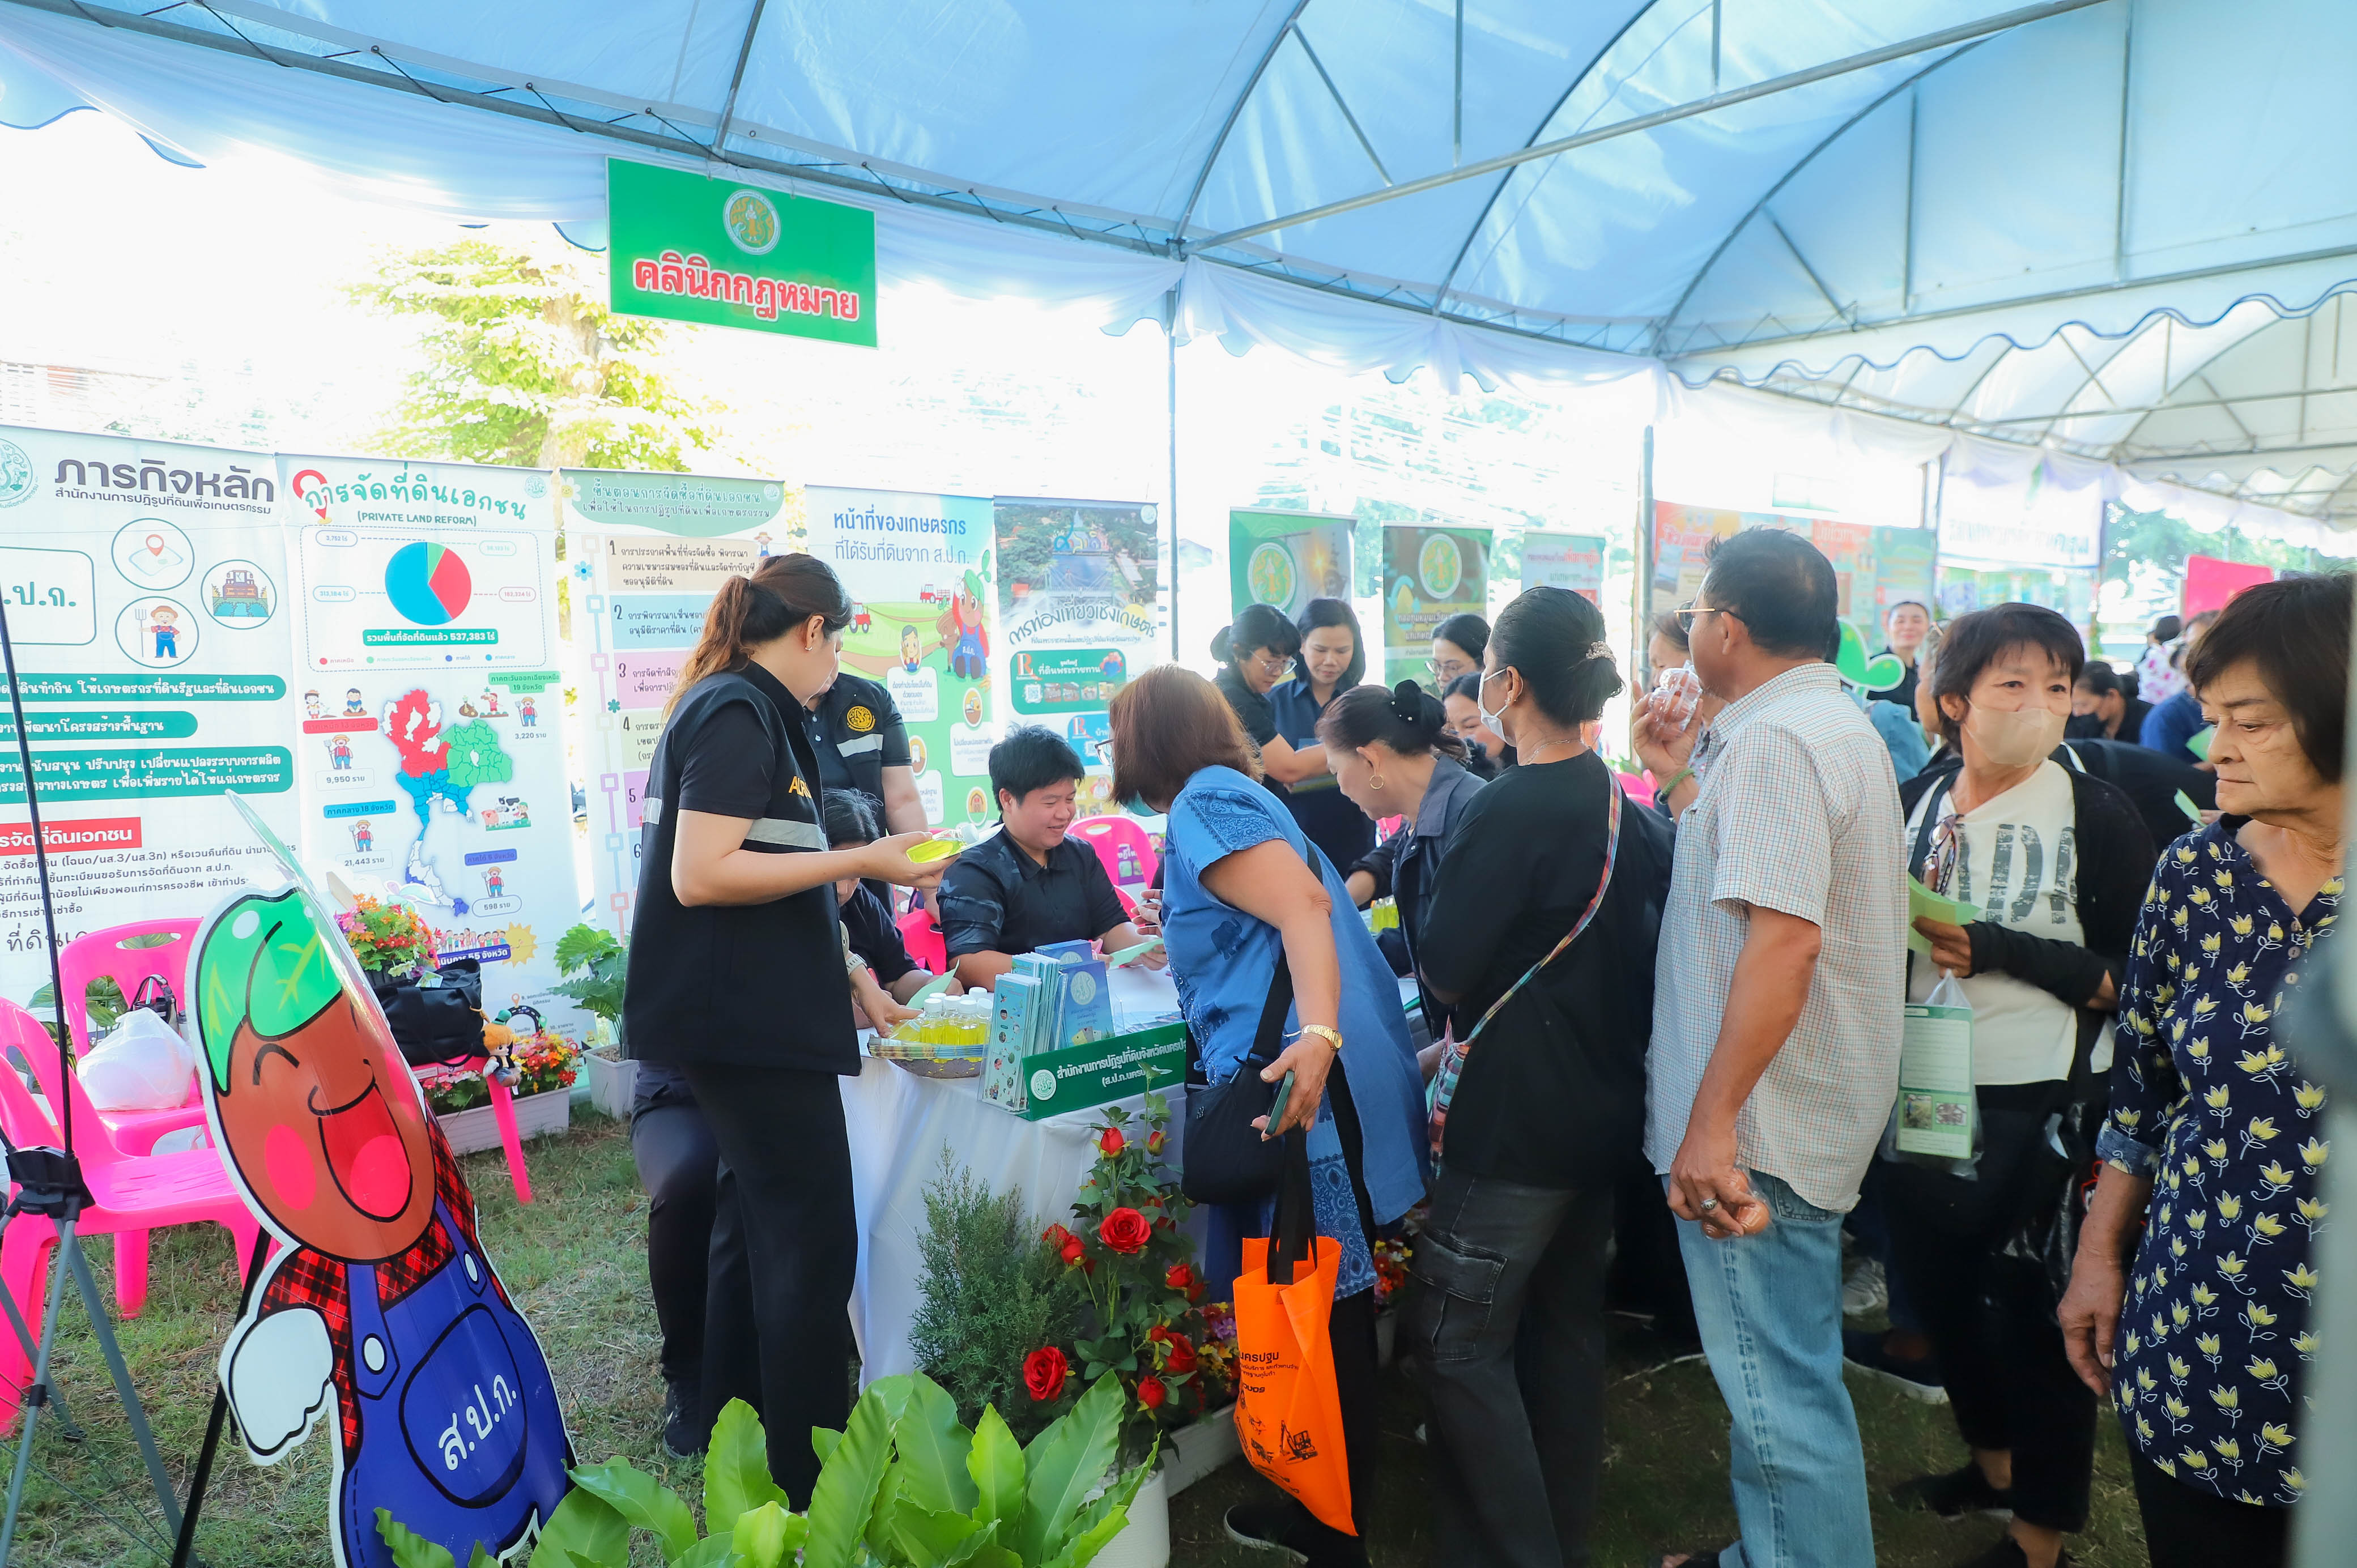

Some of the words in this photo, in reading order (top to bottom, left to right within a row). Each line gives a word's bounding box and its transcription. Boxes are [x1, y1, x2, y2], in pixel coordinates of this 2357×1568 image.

[635, 250, 858, 320] คลินิกกฎหมาย
[55, 459, 274, 502] ภารกิจหลัก
[305, 462, 526, 521] การจัดที่ดินเอกชน
[56, 488, 271, 514] สำนักงานการปฏิรูปที่ดินเพื่อเกษตรกรรม
[358, 511, 404, 523] (PRIVATE
[406, 514, 432, 523] LAND
[435, 515, 477, 527] REFORM)
[834, 504, 967, 535] หน้าที่ของเกษตรกร
[609, 540, 617, 556] 1
[835, 535, 929, 563] ที่ได้รับที่ดินจาก
[614, 604, 623, 620] 2
[367, 630, 448, 642] รวมพื้นที่จัดที่ดินแล้ว
[449, 632, 486, 642] 537,383
[619, 663, 626, 678] 3
[77, 677, 275, 697] ให้เกษตรกรที่ดินรัฐและที่ดินเอกชน
[623, 716, 631, 731] 4
[86, 758, 135, 775] ปรับปรุง
[141, 752, 281, 769] เปลี่ยนแปลงระบบการผลิต
[113, 768, 280, 788] เพื่อเพิ่มรายได้ให้แก่เกษตรกร
[326, 774, 351, 784] 9,950
[629, 788, 636, 803] 5
[171, 845, 242, 859] หรือเวนคืนที่ดิน
[344, 857, 371, 867] 21,443
[372, 856, 385, 864] ราย
[482, 949, 508, 959] จังหวัด
[439, 1374, 517, 1471] ส.ป.ก.
